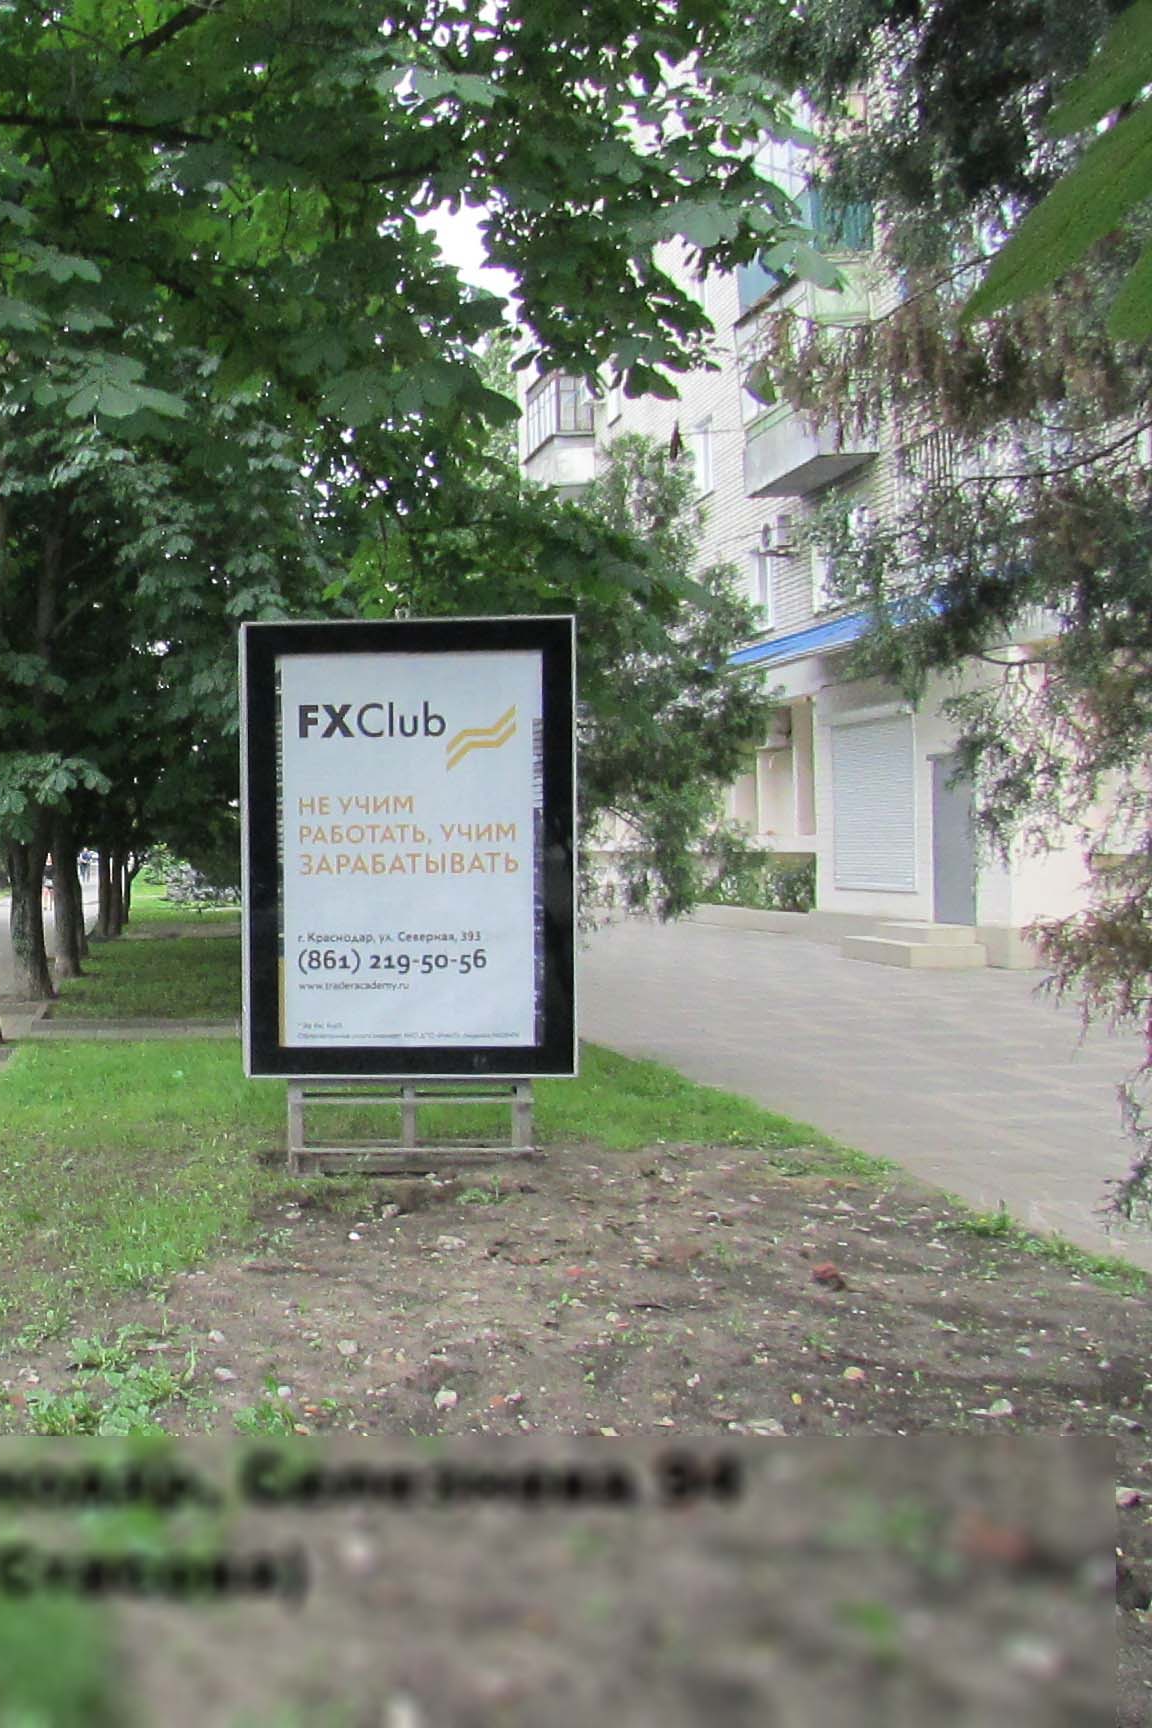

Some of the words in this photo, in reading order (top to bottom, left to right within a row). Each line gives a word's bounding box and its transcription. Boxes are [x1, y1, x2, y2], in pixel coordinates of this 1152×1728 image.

[298, 700, 447, 738] FXClub
[298, 796, 331, 816] НЕ
[338, 795, 417, 816] УЧИМ
[299, 824, 433, 845] РАБОТАТЬ,
[440, 823, 517, 843] УЧИМ
[299, 852, 520, 876] ЗАРАБАТЫВАТЬ
[307, 932, 376, 944] Краснодар,
[397, 931, 458, 944] Северная,
[461, 931, 481, 942] 393
[298, 948, 361, 975] (861)
[369, 948, 488, 975] 219-50-56
